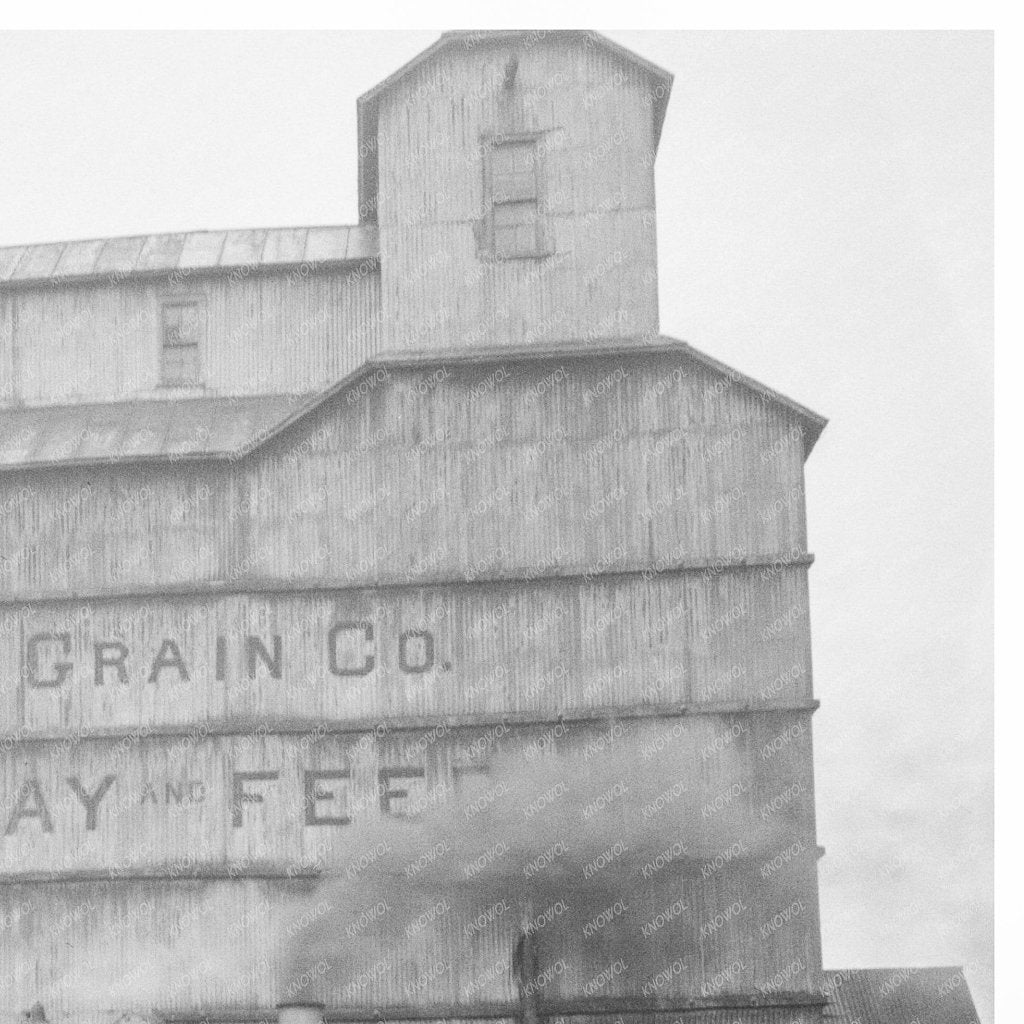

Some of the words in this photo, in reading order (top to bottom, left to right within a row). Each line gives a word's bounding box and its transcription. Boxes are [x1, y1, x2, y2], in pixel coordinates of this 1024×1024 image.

[27, 632, 282, 689] GRAIN
[140, 781, 206, 804] AND
[232, 765, 490, 826] FEE
